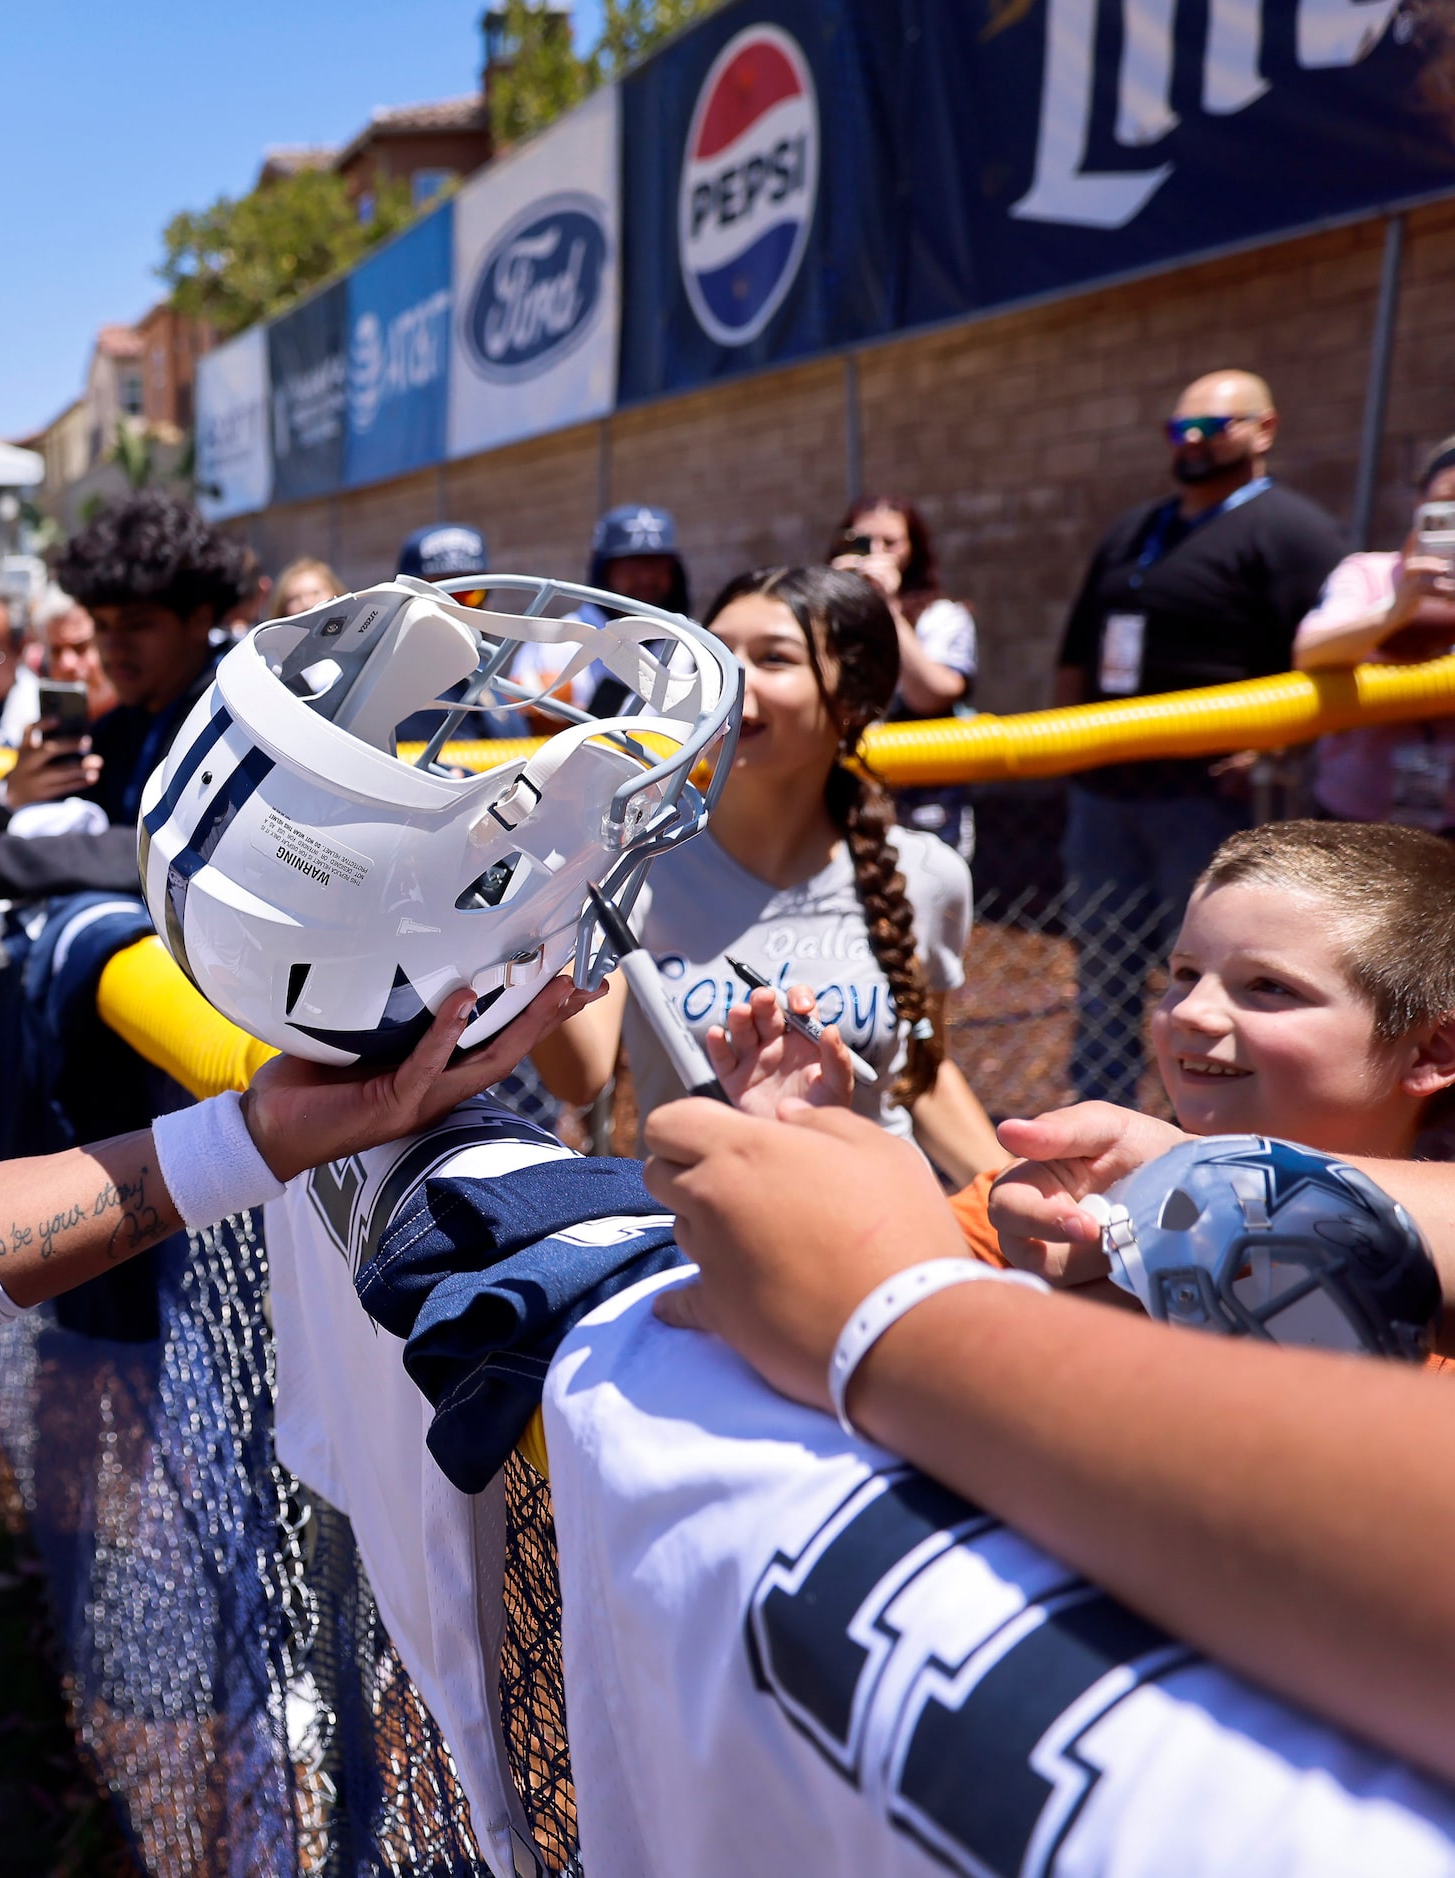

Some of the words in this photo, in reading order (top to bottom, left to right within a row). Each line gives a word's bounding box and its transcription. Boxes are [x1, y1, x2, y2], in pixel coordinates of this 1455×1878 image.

[690, 134, 809, 239] PEPSI
[480, 225, 587, 359] Ford
[277, 827, 285, 835] USE
[284, 823, 292, 832] THIS
[293, 829, 304, 838] WEAR
[287, 834, 296, 842] FOR
[282, 839, 298, 851] DISPLAY
[298, 841, 319, 855] INTENDED
[298, 849, 307, 857] FOR
[276, 846, 330, 886] WARNING
[313, 858, 331, 870] HELMET
[330, 859, 352, 874] DESIGNED
[341, 857, 368, 874] PROTECTIVE
[332, 868, 350, 880] REPLICA
[350, 878, 360, 886] THIS
[10, 1222, 33, 1253] be
[39, 1204, 85, 1259] your
